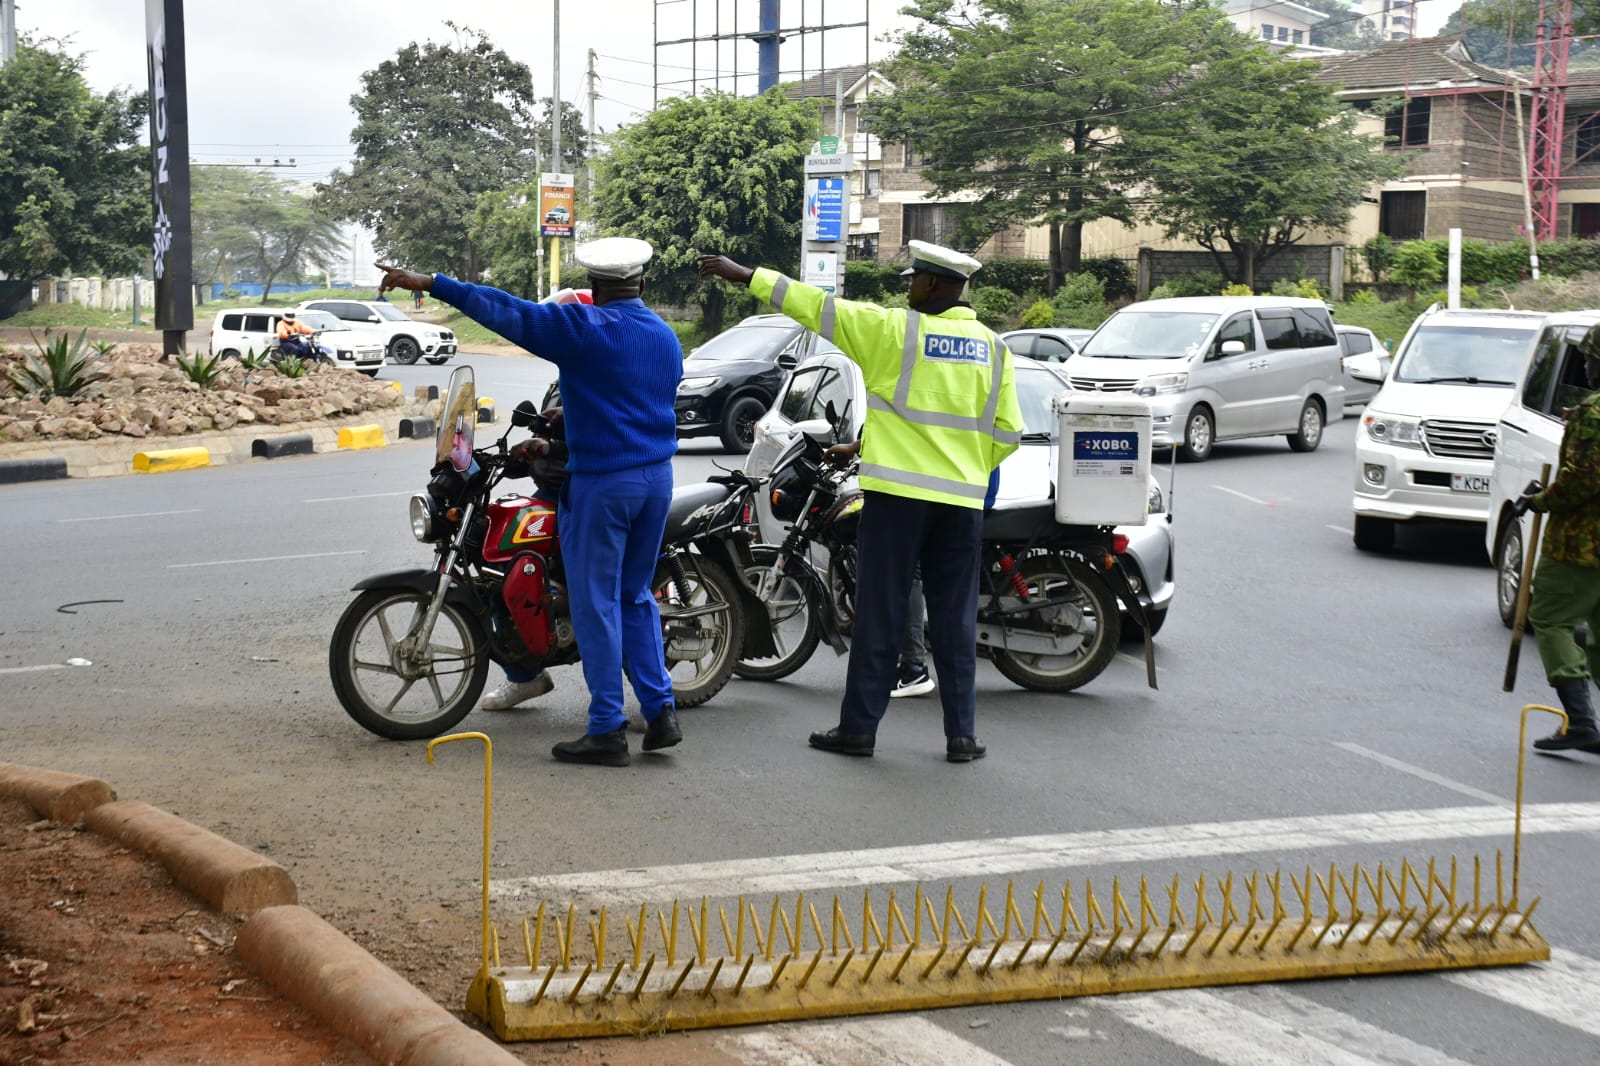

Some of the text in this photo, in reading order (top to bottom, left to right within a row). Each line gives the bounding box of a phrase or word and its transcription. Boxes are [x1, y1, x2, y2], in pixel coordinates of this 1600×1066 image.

[829, 157, 842, 165] ROAD
[928, 337, 985, 358] POLICE
[1092, 439, 1130, 450] XOBO
[1464, 477, 1490, 491] KCH
